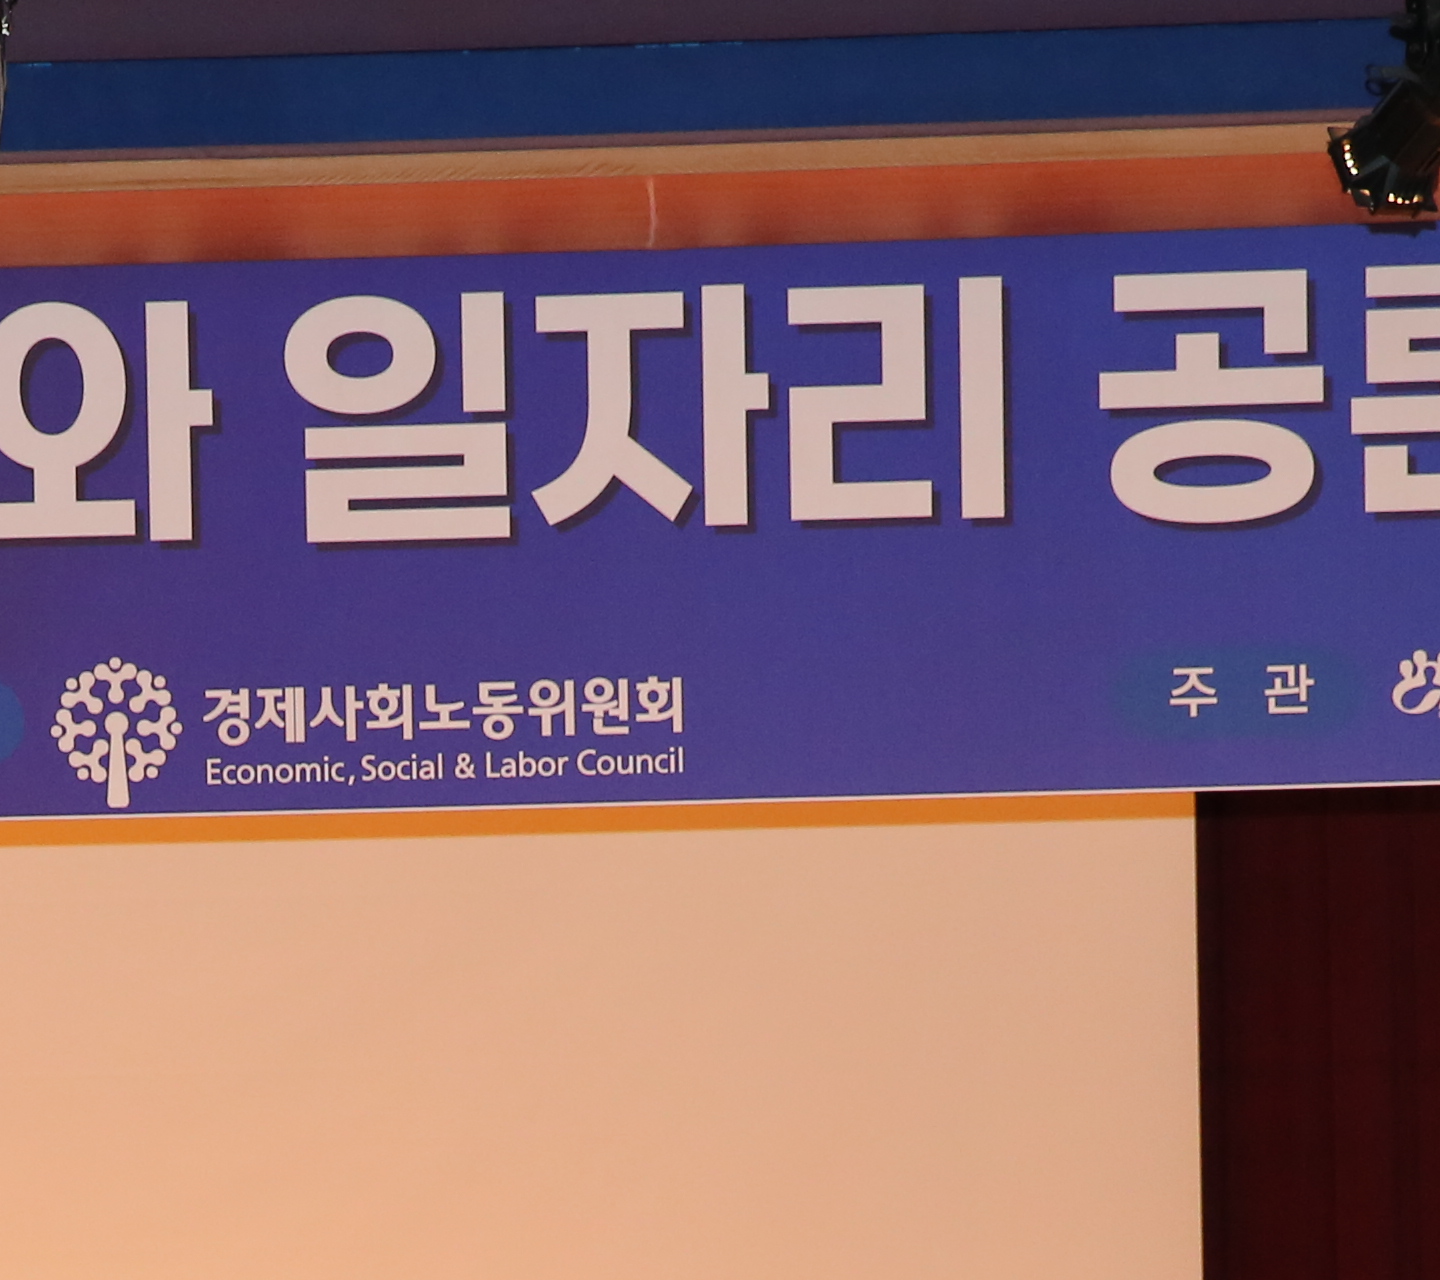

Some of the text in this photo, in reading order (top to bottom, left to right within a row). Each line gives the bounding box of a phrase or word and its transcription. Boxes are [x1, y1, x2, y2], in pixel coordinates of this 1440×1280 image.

[284, 276, 1006, 543] 일자리
[202, 676, 684, 747] 경제사회노동위원회
[206, 746, 684, 786] Economic, Social & Labor Council
